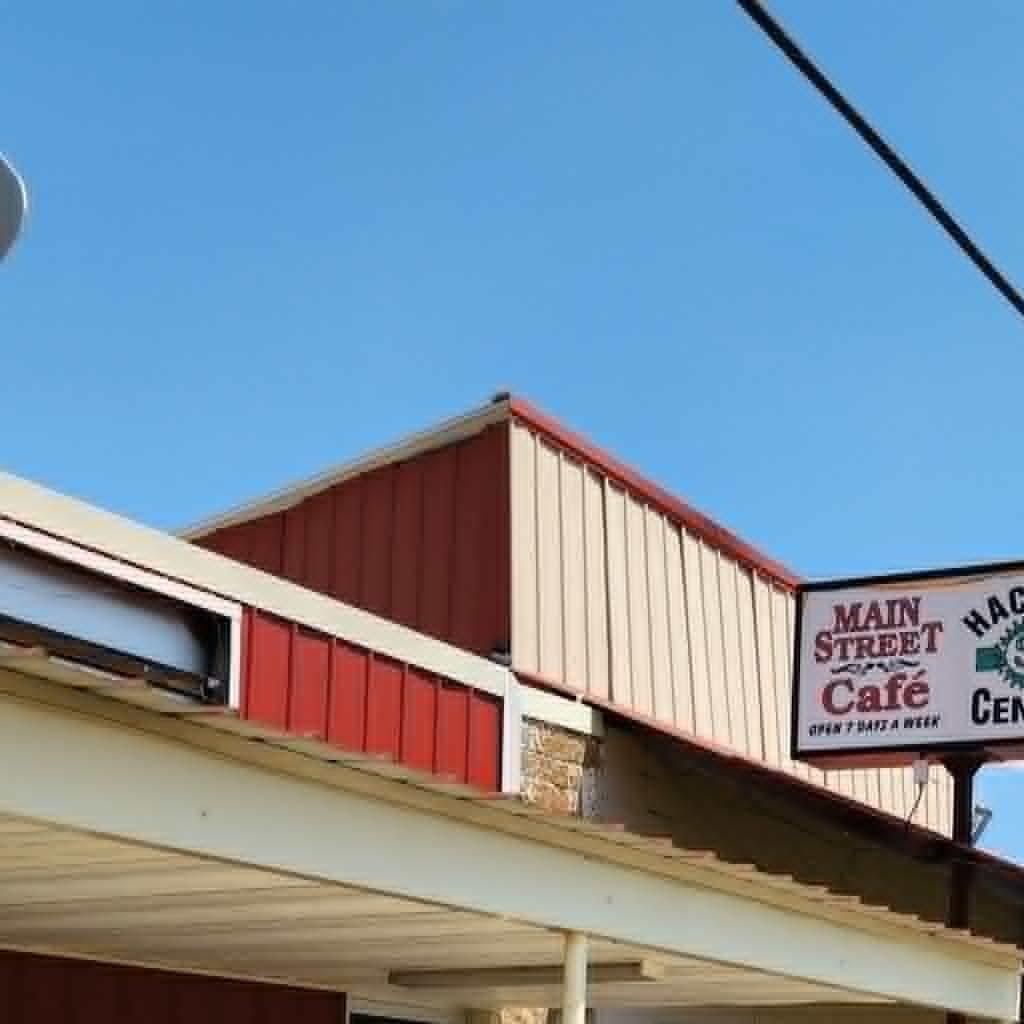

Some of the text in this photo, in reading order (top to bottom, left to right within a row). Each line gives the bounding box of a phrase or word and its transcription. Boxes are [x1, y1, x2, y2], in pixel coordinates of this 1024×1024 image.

[832, 597, 921, 634] MAIN
[814, 621, 943, 664] STREET
[821, 668, 929, 715] Café
[808, 723, 842, 736] OPEN
[891, 719, 899, 731] A
[903, 715, 941, 729] WEEK
